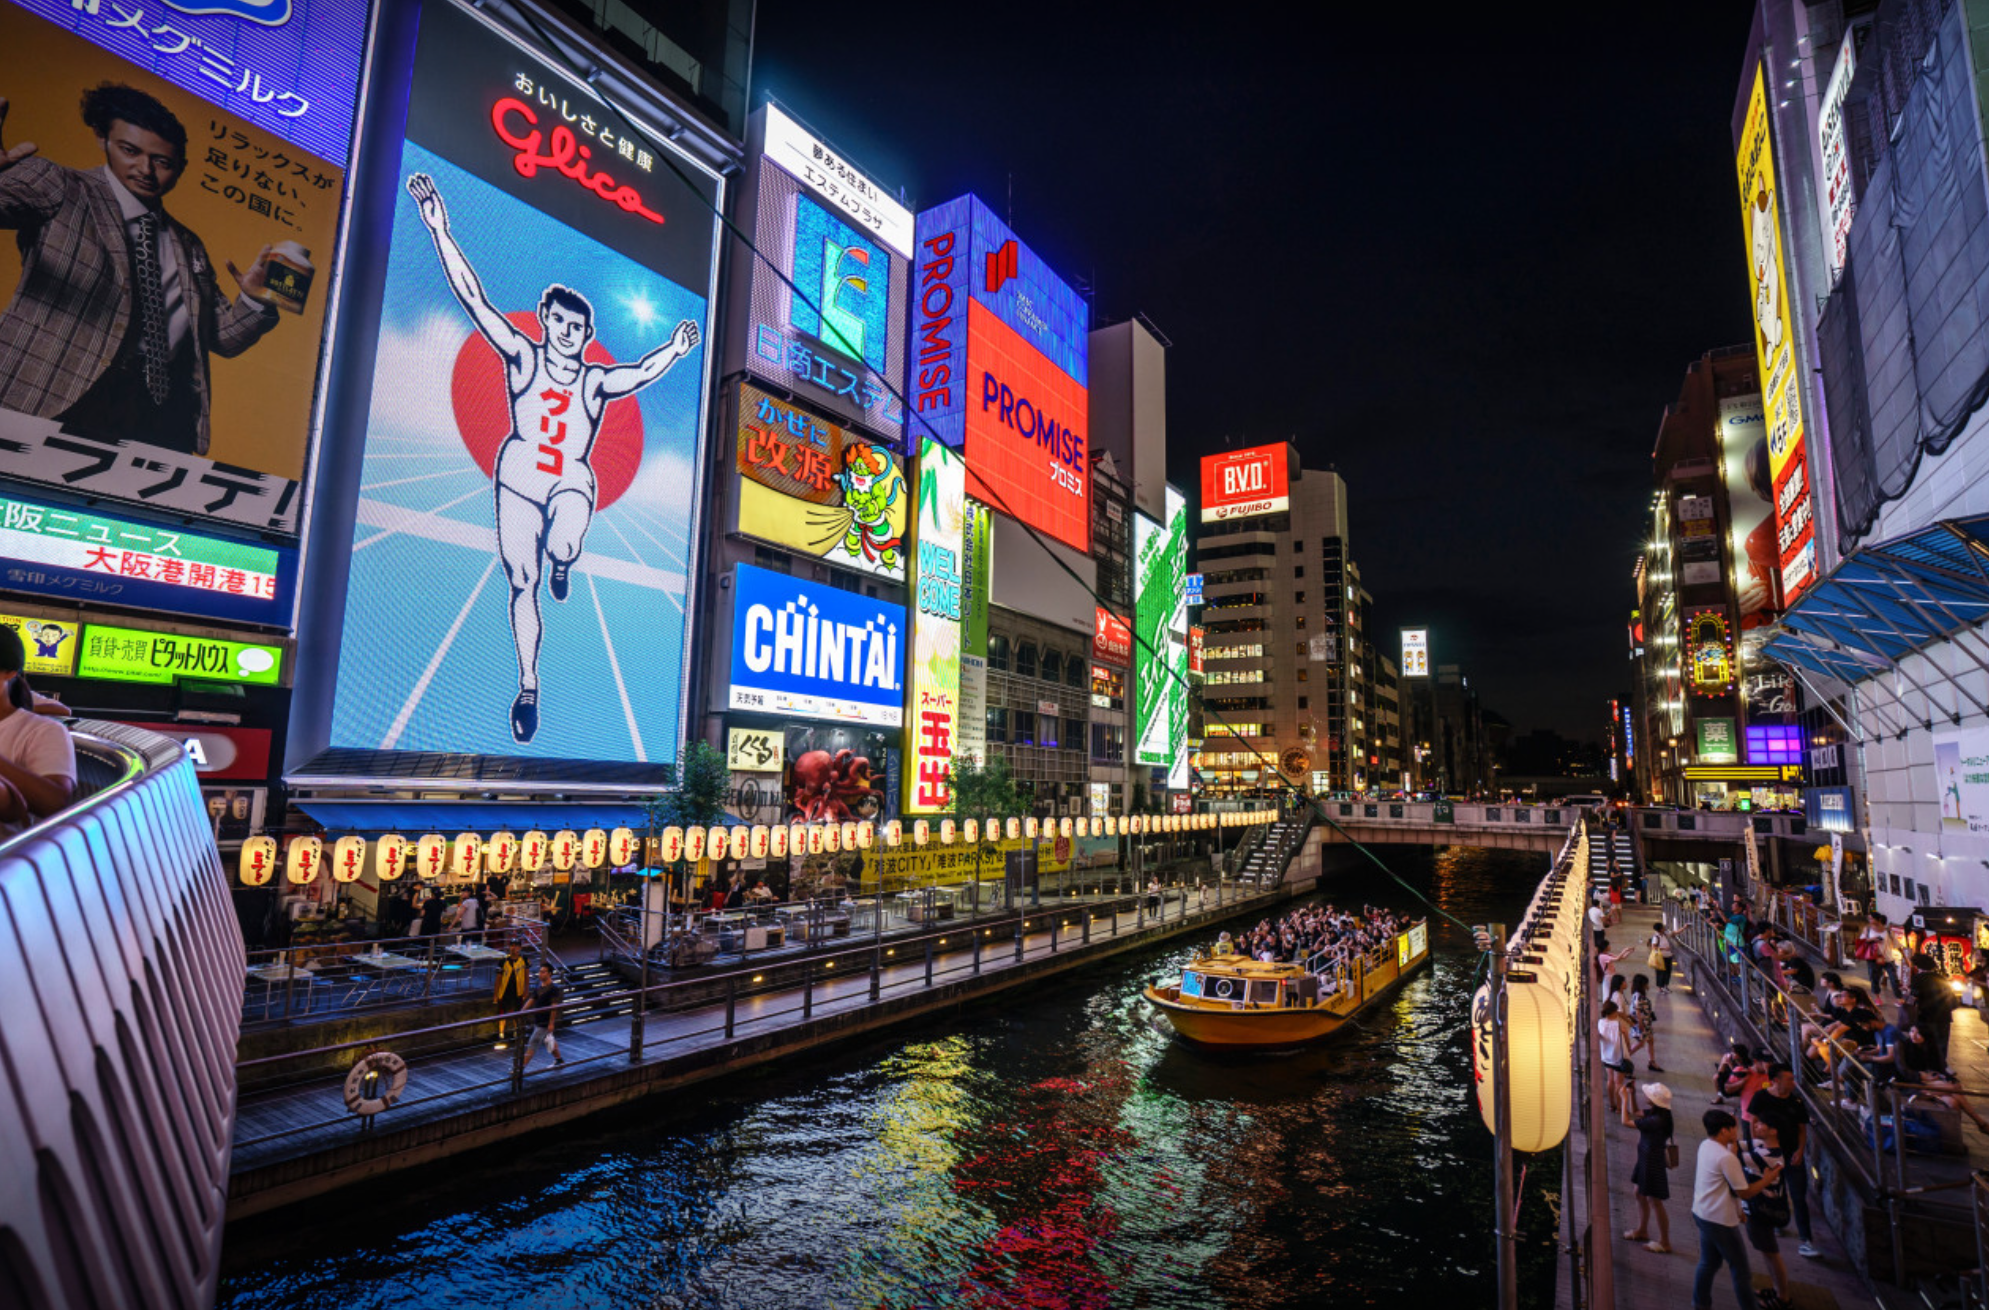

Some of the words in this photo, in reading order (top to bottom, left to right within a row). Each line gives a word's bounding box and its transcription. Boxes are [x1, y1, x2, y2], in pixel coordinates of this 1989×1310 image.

[513, 72, 653, 173] おいしさと健康
[208, 120, 335, 191] リラックスが
[491, 97, 665, 225] Glico
[803, 165, 883, 231] エステムプラザ
[918, 231, 955, 413] PROMISE
[758, 324, 904, 425] 日商エステム
[536, 387, 574, 477] グリコ
[757, 397, 828, 447] かぜに
[982, 371, 1084, 474] PROMISE
[747, 425, 834, 491] 改源
[1049, 461, 1084, 497] プロミス
[1224, 462, 1267, 494] B.V.D.
[0, 499, 182, 556] 阪ニュース
[1229, 501, 1272, 515] FUJIBO
[7, 568, 124, 595] 雪印メグミルク
[919, 575, 961, 620] COME
[151, 638, 229, 674] ピタットハウス
[921, 691, 952, 707] スーパー
[739, 734, 773, 765] くくる
[918, 711, 951, 806] 玉出
